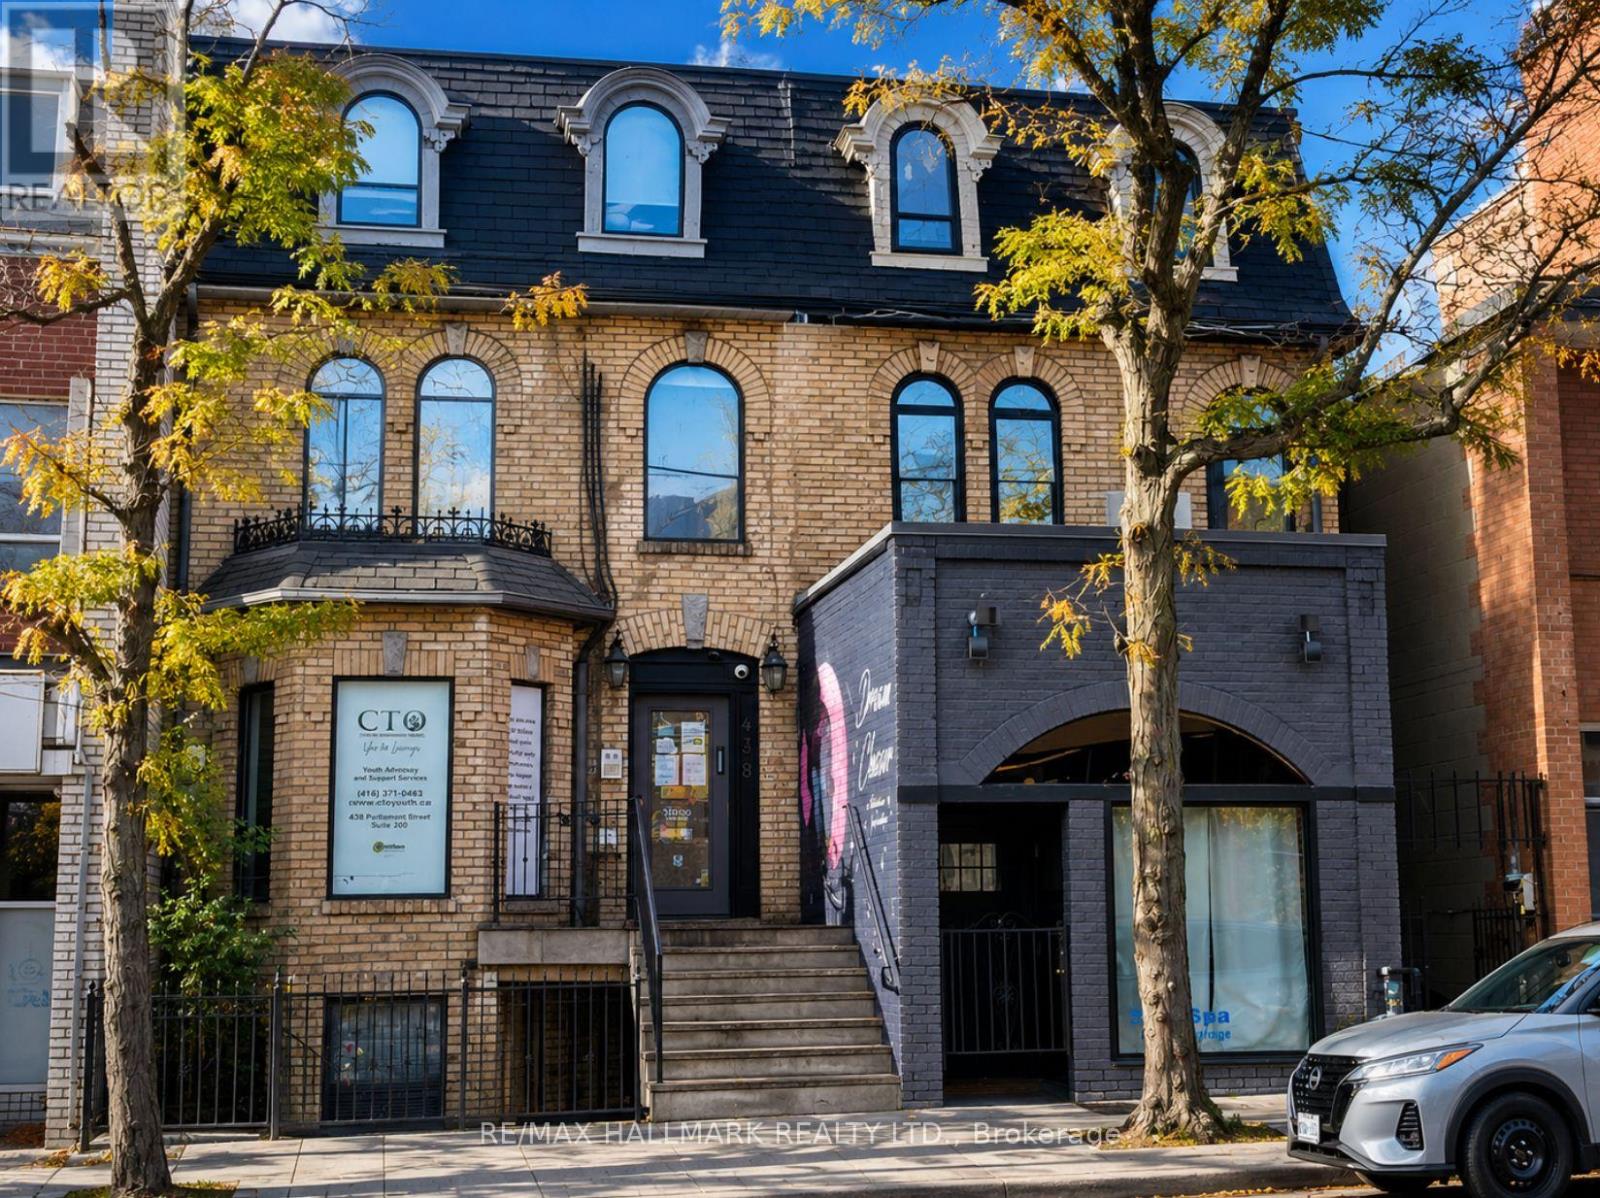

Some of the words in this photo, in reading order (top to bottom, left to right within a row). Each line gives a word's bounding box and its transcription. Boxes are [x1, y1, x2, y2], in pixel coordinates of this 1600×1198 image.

[357, 709, 427, 731] CTO
[368, 774, 396, 783] Support
[357, 789, 380, 798] (416)
[371, 821, 390, 829] Suite
[1191, 1008, 1230, 1026] Spa
